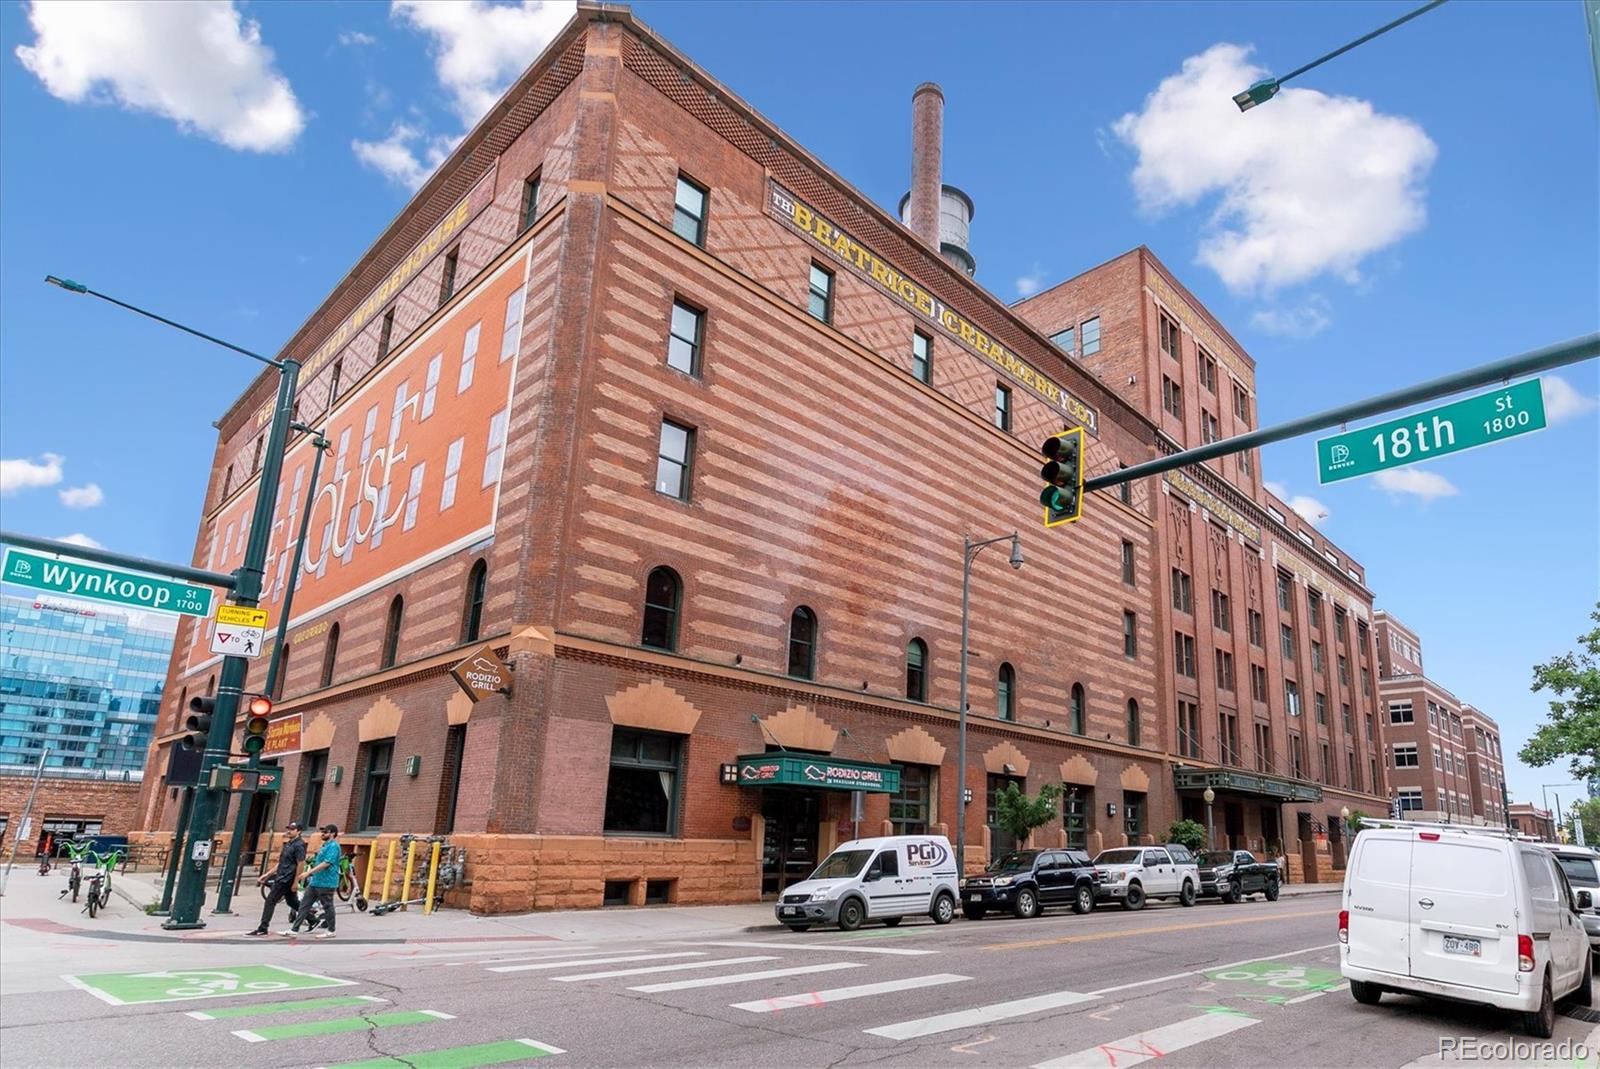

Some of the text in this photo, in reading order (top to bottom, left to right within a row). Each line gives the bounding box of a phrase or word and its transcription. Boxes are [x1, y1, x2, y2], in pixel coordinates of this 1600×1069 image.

[1495, 394, 1513, 412] St
[1483, 411, 1530, 435] 1800
[1371, 415, 1456, 463] 18th
[43, 562, 171, 607] Wynkoop
[185, 589, 197, 600] St
[176, 599, 203, 612] 1700
[222, 607, 251, 617] TURNING
[219, 615, 250, 624] VEHICLES
[231, 635, 240, 643] TO
[466, 671, 502, 684] RODIZIO
[471, 680, 496, 691] GRILL
[827, 766, 882, 782] RODIZIO GRILL
